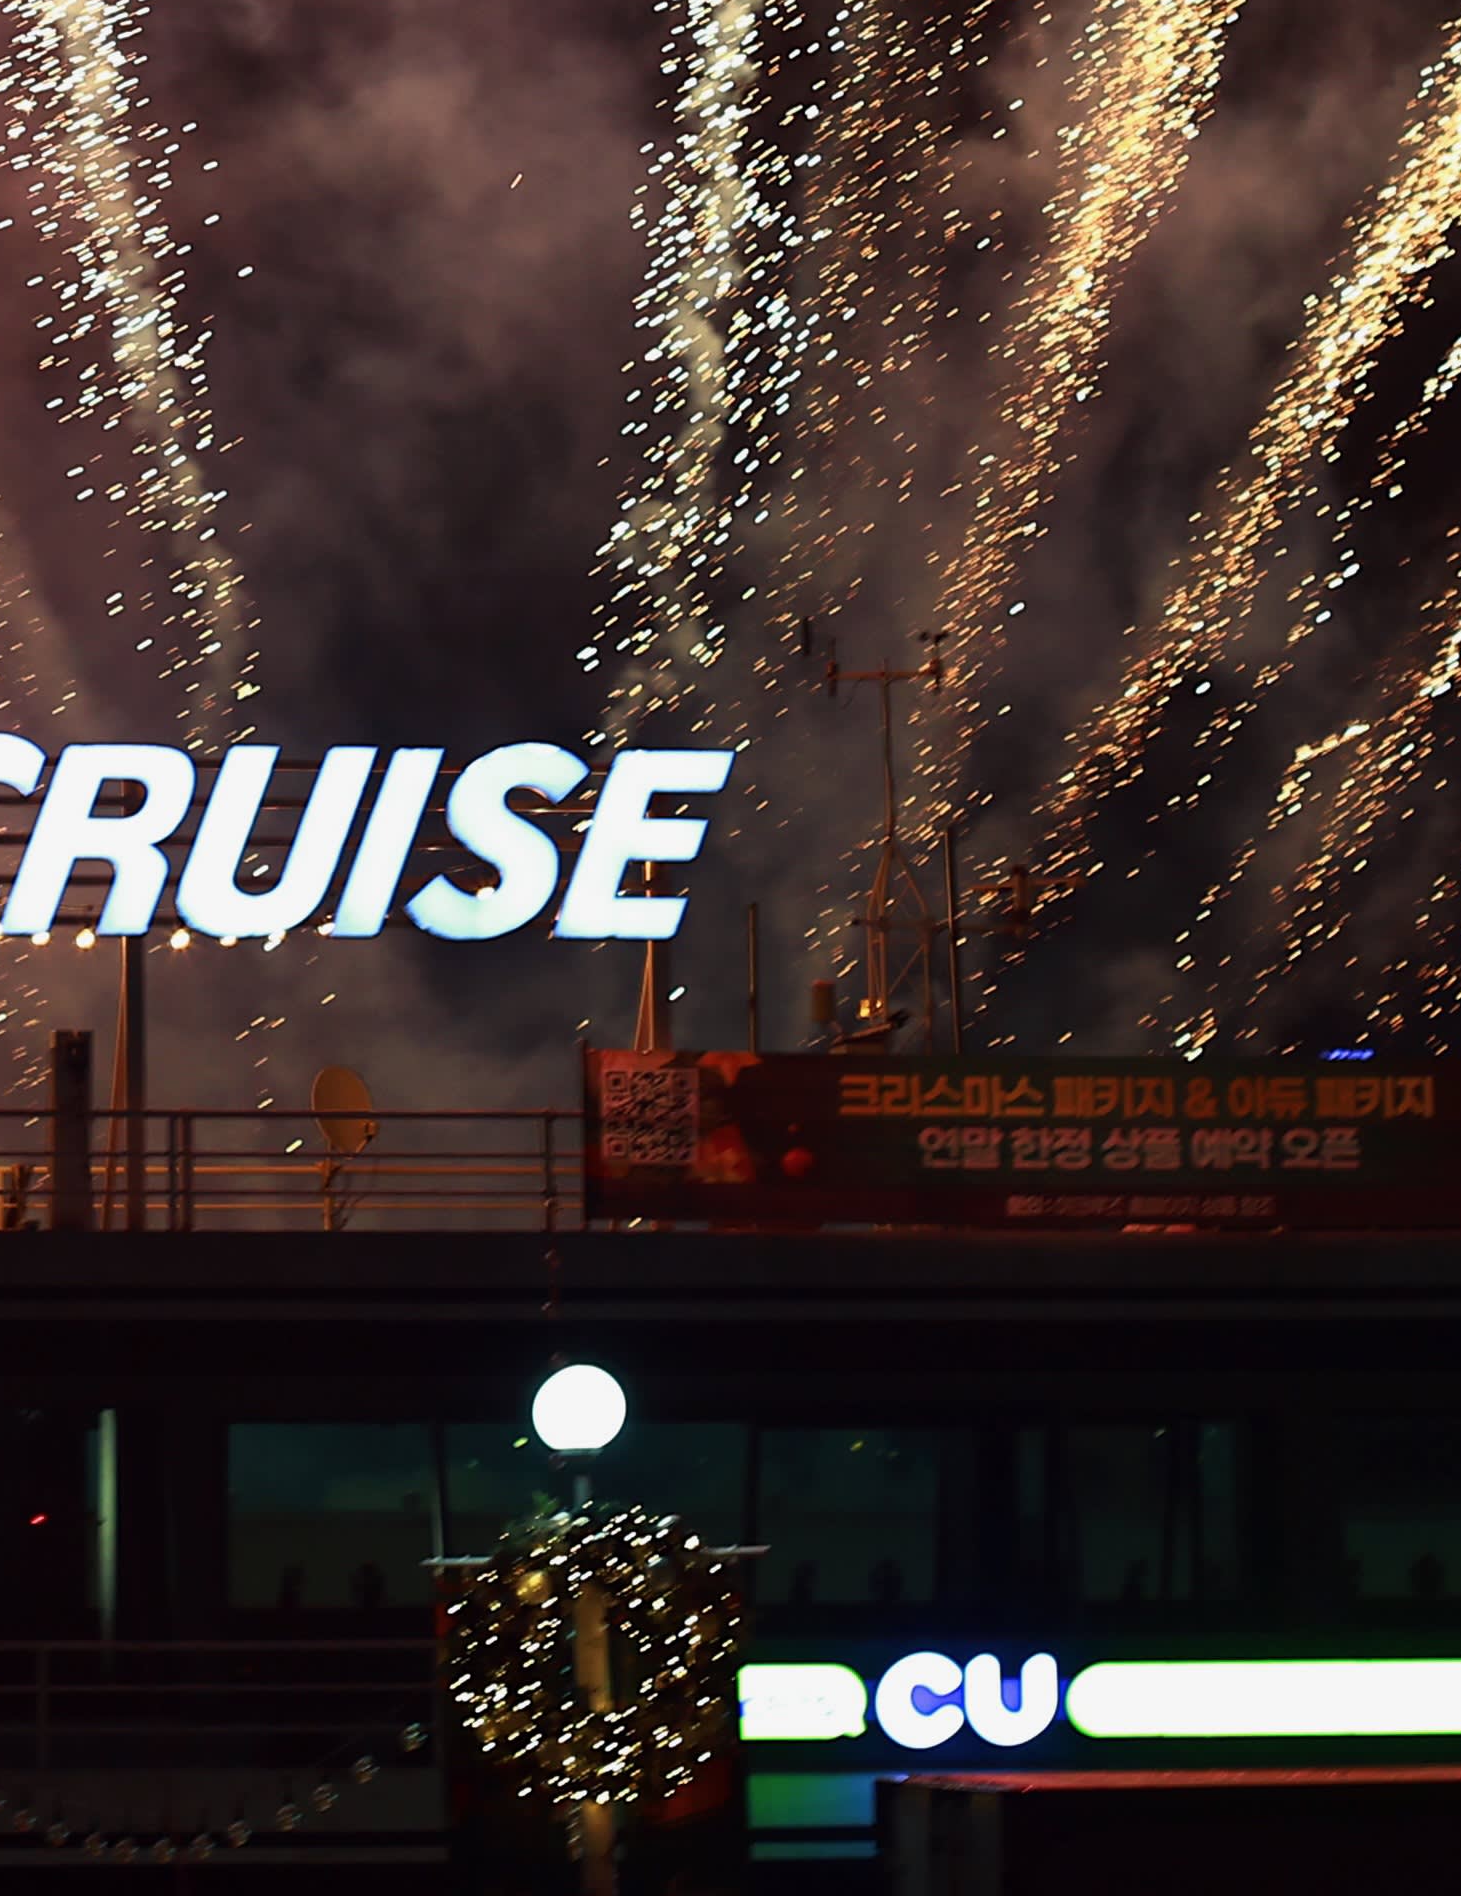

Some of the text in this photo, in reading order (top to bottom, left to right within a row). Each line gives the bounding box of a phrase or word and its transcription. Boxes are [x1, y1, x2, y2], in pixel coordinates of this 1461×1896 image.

[838, 1074, 1044, 1118] 크리스마스
[1052, 1075, 1173, 1119] 패키지
[1185, 1077, 1218, 1117] &
[1315, 1075, 1435, 1119] 패키지
[917, 1126, 1363, 1170] 연말 한정 상품 예약 오픈
[875, 1649, 1059, 1751] CU
